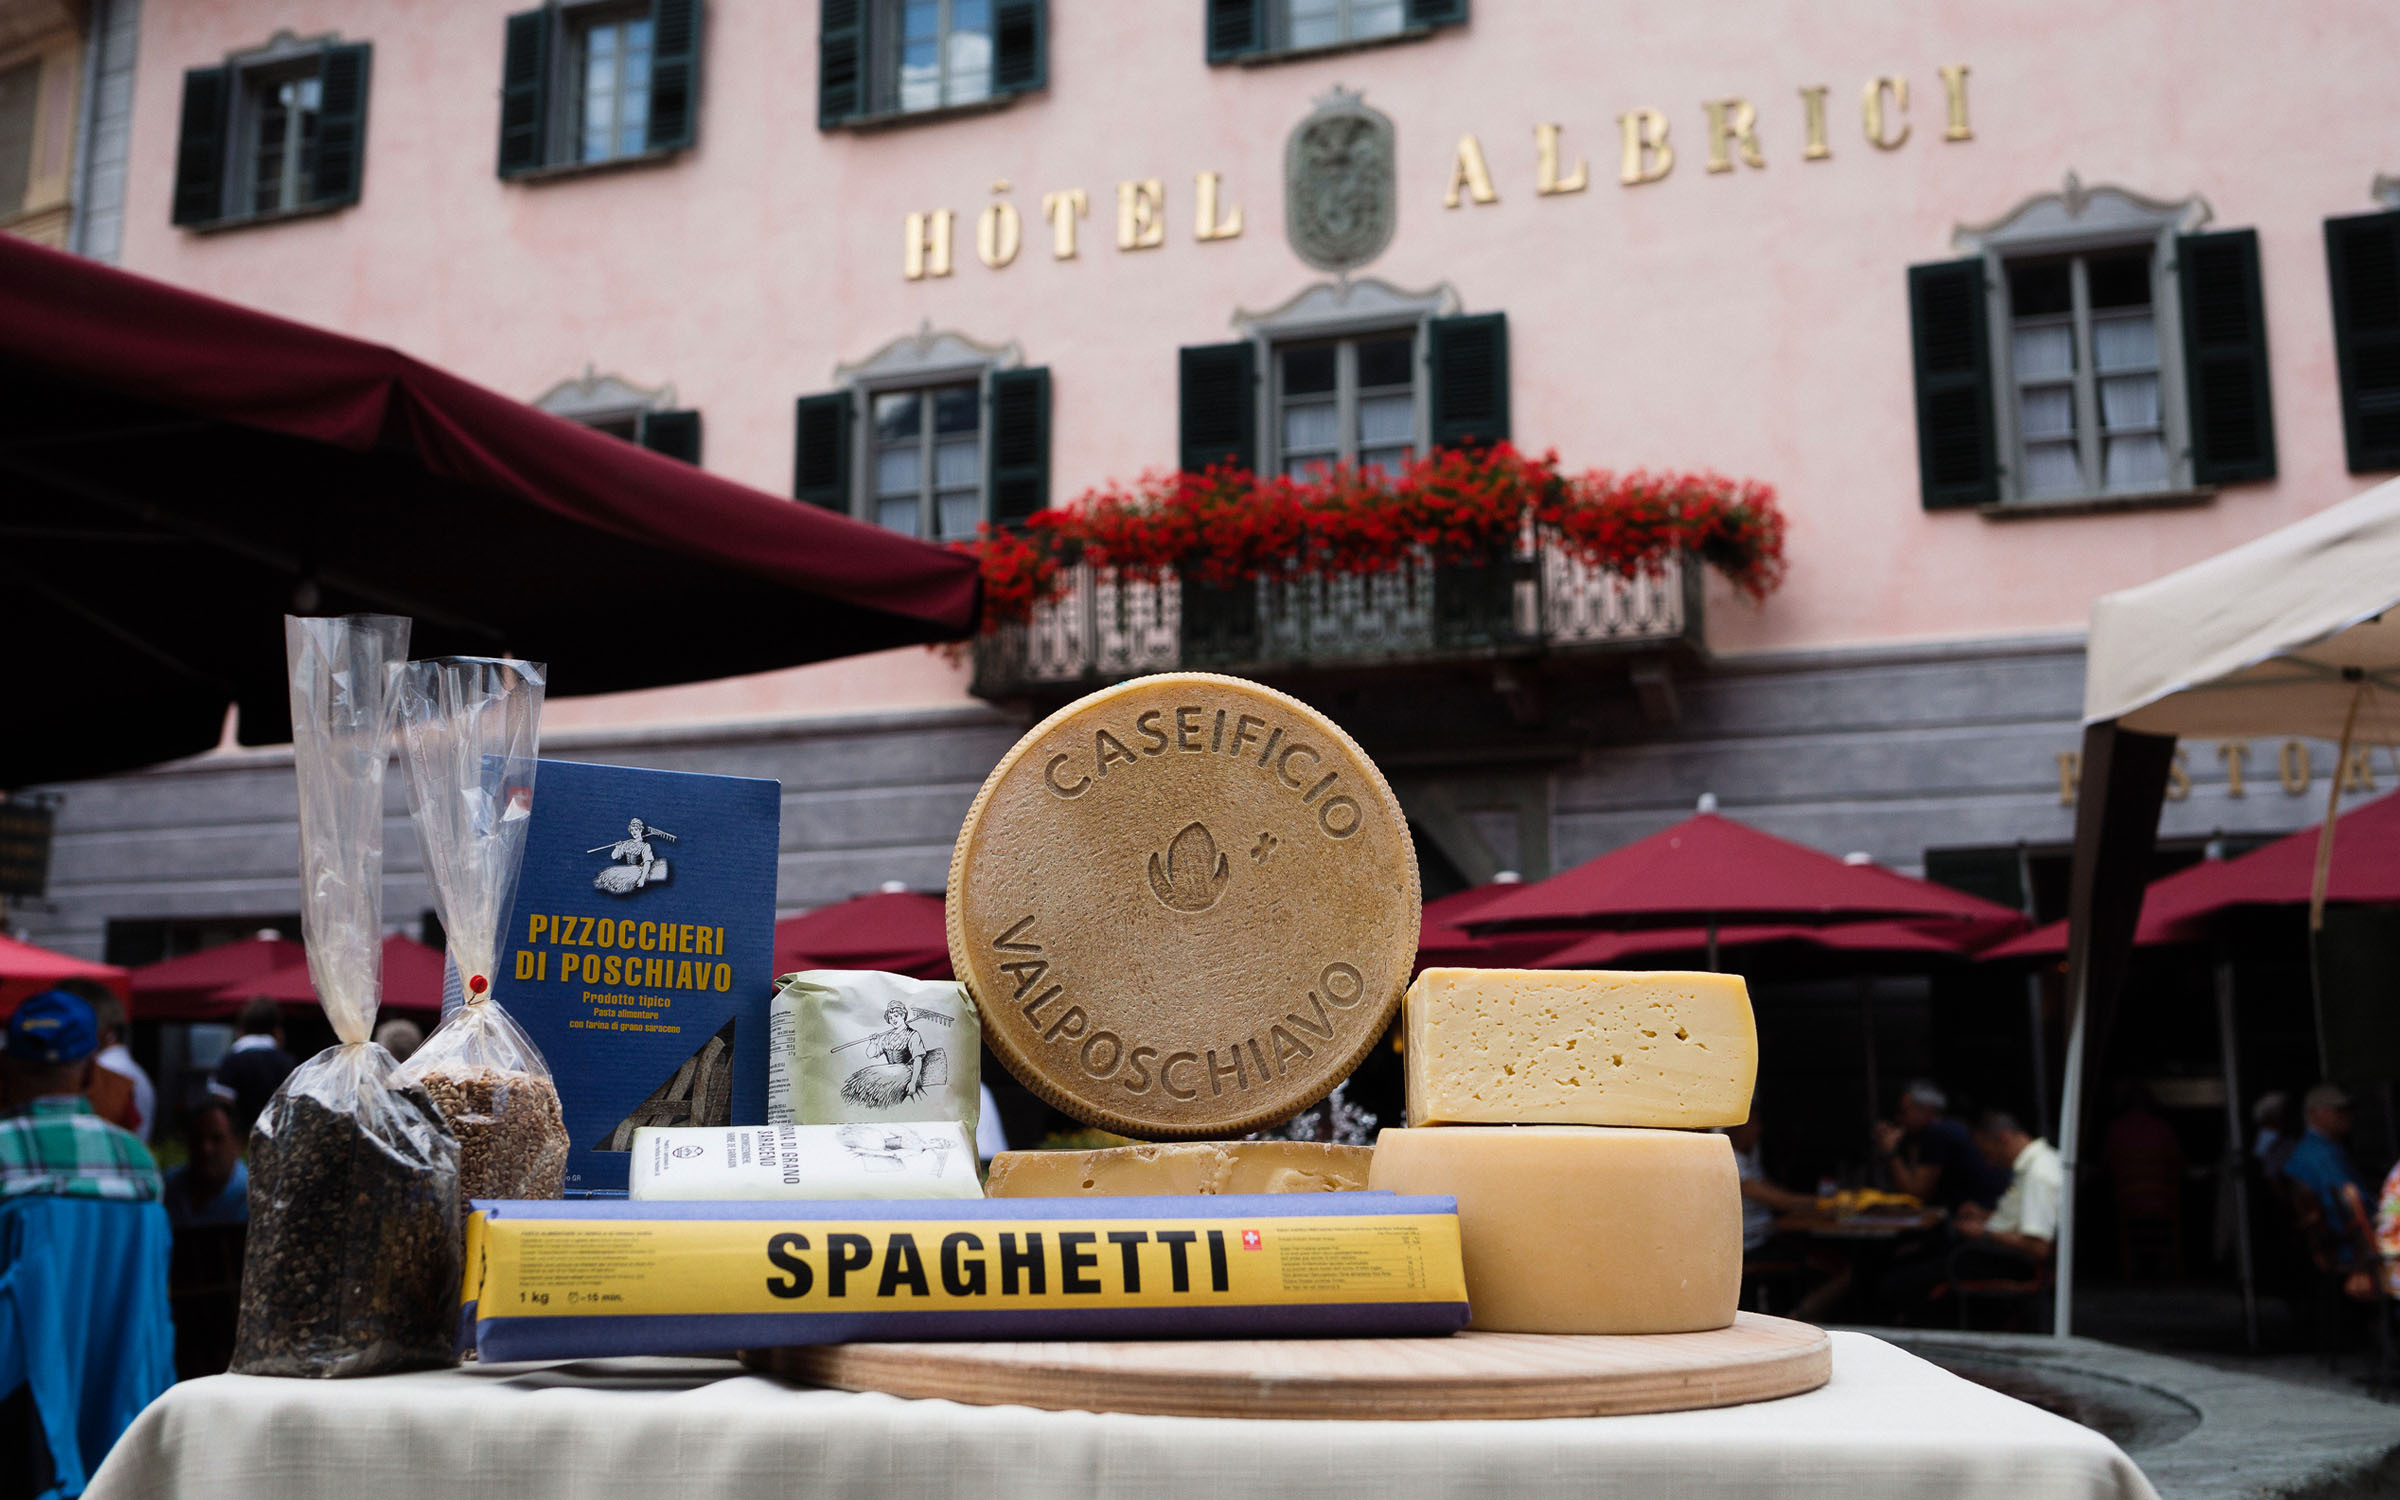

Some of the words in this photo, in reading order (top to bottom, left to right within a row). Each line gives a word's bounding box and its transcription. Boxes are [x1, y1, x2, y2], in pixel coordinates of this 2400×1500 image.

[902, 171, 1246, 281] HÔTEL
[1443, 65, 1975, 208] ALBRICI
[1043, 705, 1363, 841] CASEIFICIO
[528, 913, 725, 956] PIZZOCCHERI
[515, 950, 547, 981] DI
[560, 952, 731, 993] POSCHIAVO
[582, 991, 635, 1006] Prodotto
[639, 994, 671, 1009] tipico
[593, 1007, 616, 1018] Pasta
[617, 1008, 659, 1020] alimentare
[993, 915, 1364, 1100] VALPOSCHIAVO
[569, 1020, 584, 1029] con
[585, 1020, 609, 1031] farina
[611, 1021, 619, 1031] di
[620, 1023, 643, 1033] grano
[645, 1024, 681, 1034] saraceno
[782, 1152, 800, 1185] GRANO
[766, 1229, 1230, 1300] SPAGHETTI
[520, 1292, 526, 1302] 1
[531, 1291, 550, 1305] kg
